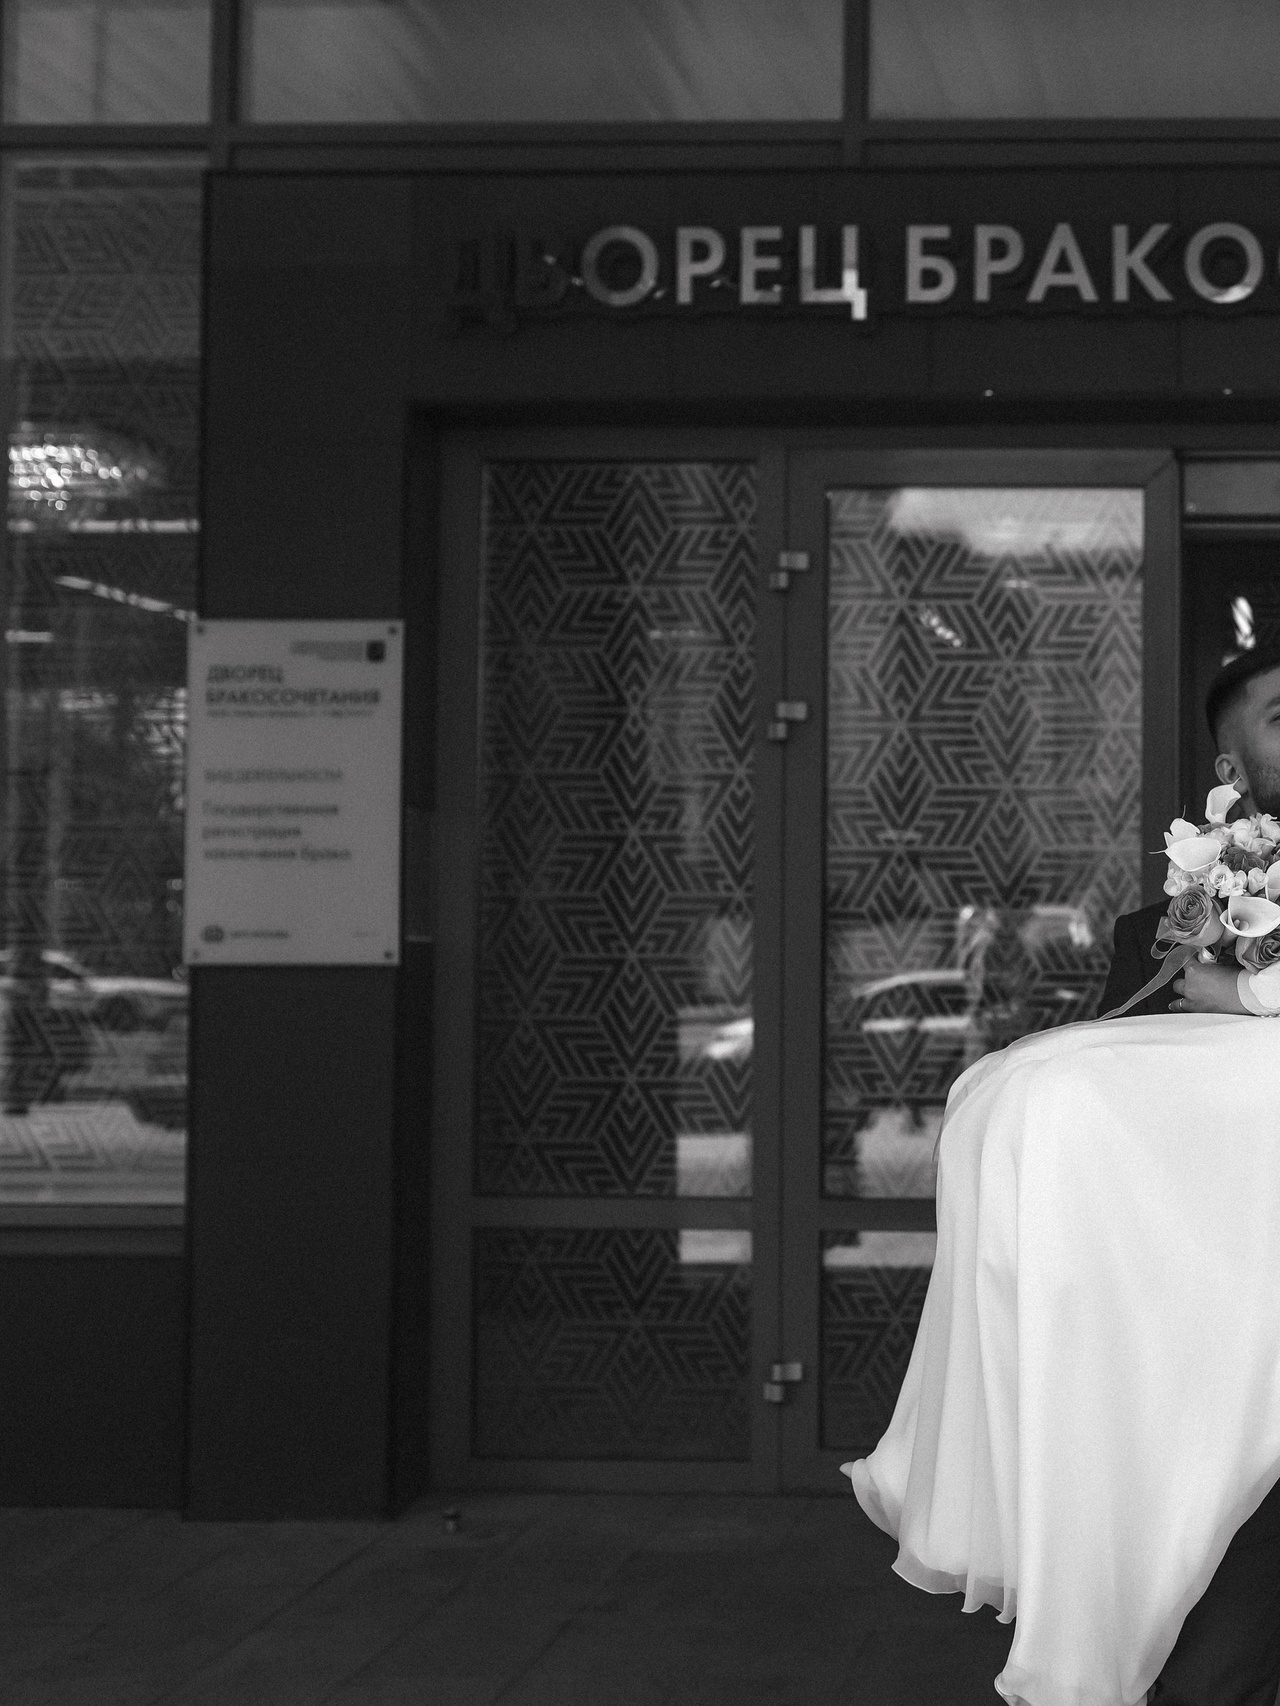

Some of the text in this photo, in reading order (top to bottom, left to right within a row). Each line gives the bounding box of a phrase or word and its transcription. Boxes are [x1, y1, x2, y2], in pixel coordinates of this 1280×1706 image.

[446, 224, 868, 325] ДВОРЕЦ
[206, 665, 284, 684] ДВОРЕЦ
[206, 688, 381, 705] БРАКОСОЧЕТАНИЯ
